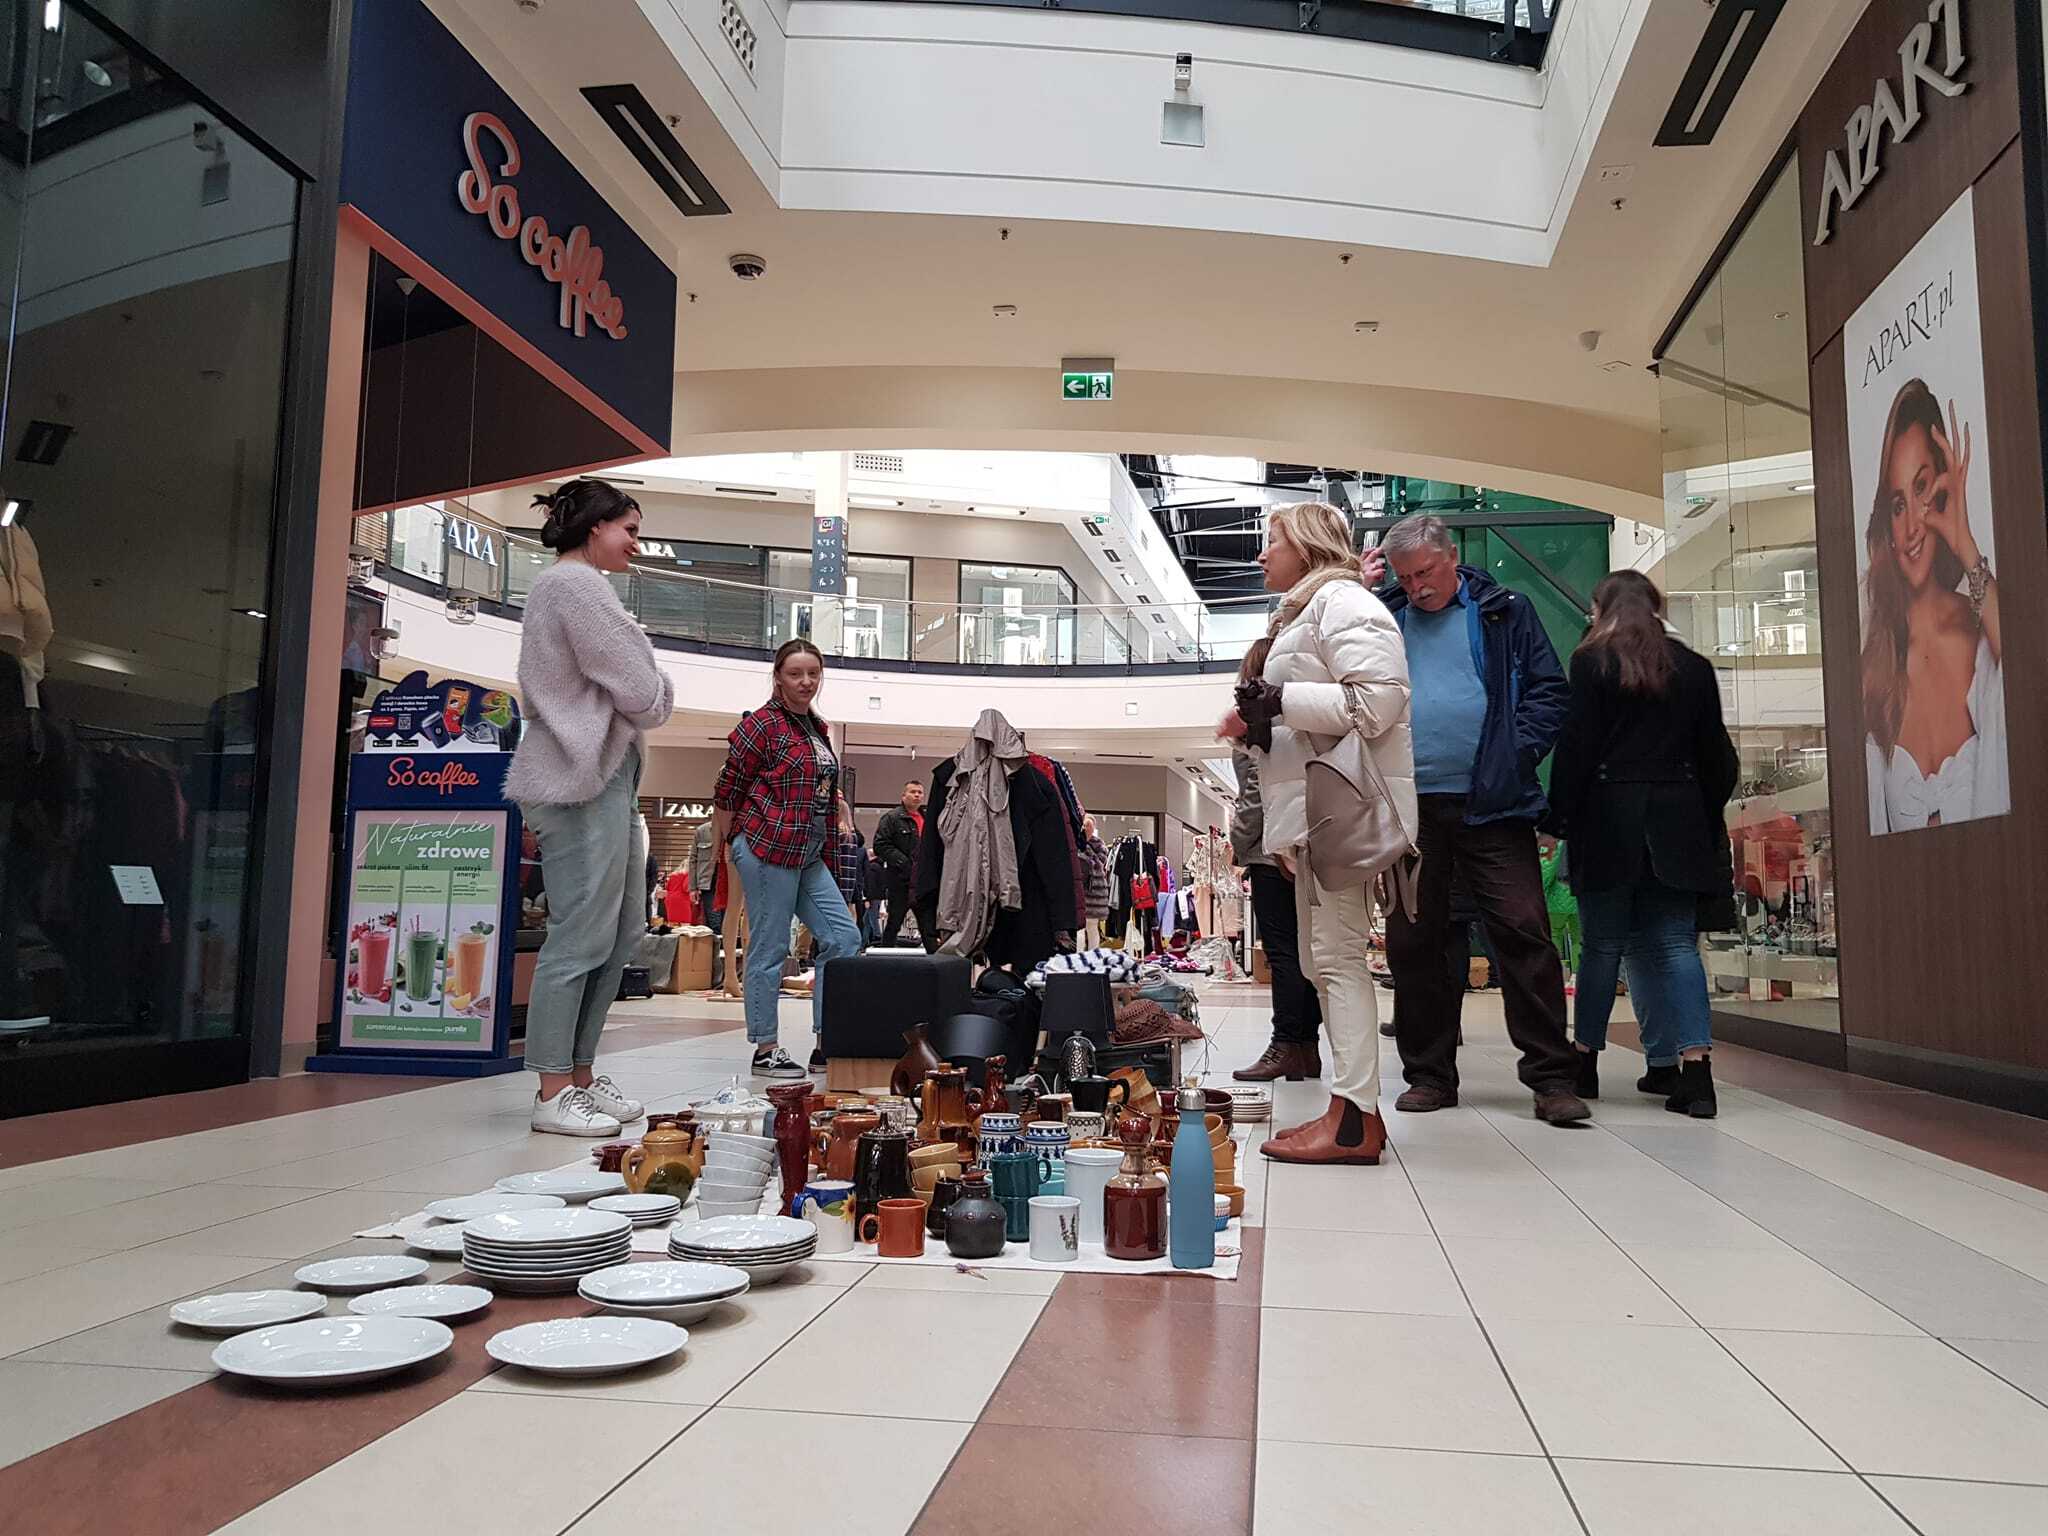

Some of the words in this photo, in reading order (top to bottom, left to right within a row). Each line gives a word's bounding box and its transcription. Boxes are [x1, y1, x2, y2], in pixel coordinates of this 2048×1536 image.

[1813, 0, 1968, 246] APART
[520, 217, 628, 340] coffee
[1862, 269, 1953, 388] APART.pl
[443, 517, 499, 567] ARA
[640, 541, 676, 558] ARA
[388, 757, 415, 786] So
[417, 761, 480, 795] coffee
[665, 802, 714, 818] ZARA
[357, 812, 492, 860] Naturalnie
[417, 840, 490, 859] zdrowe
